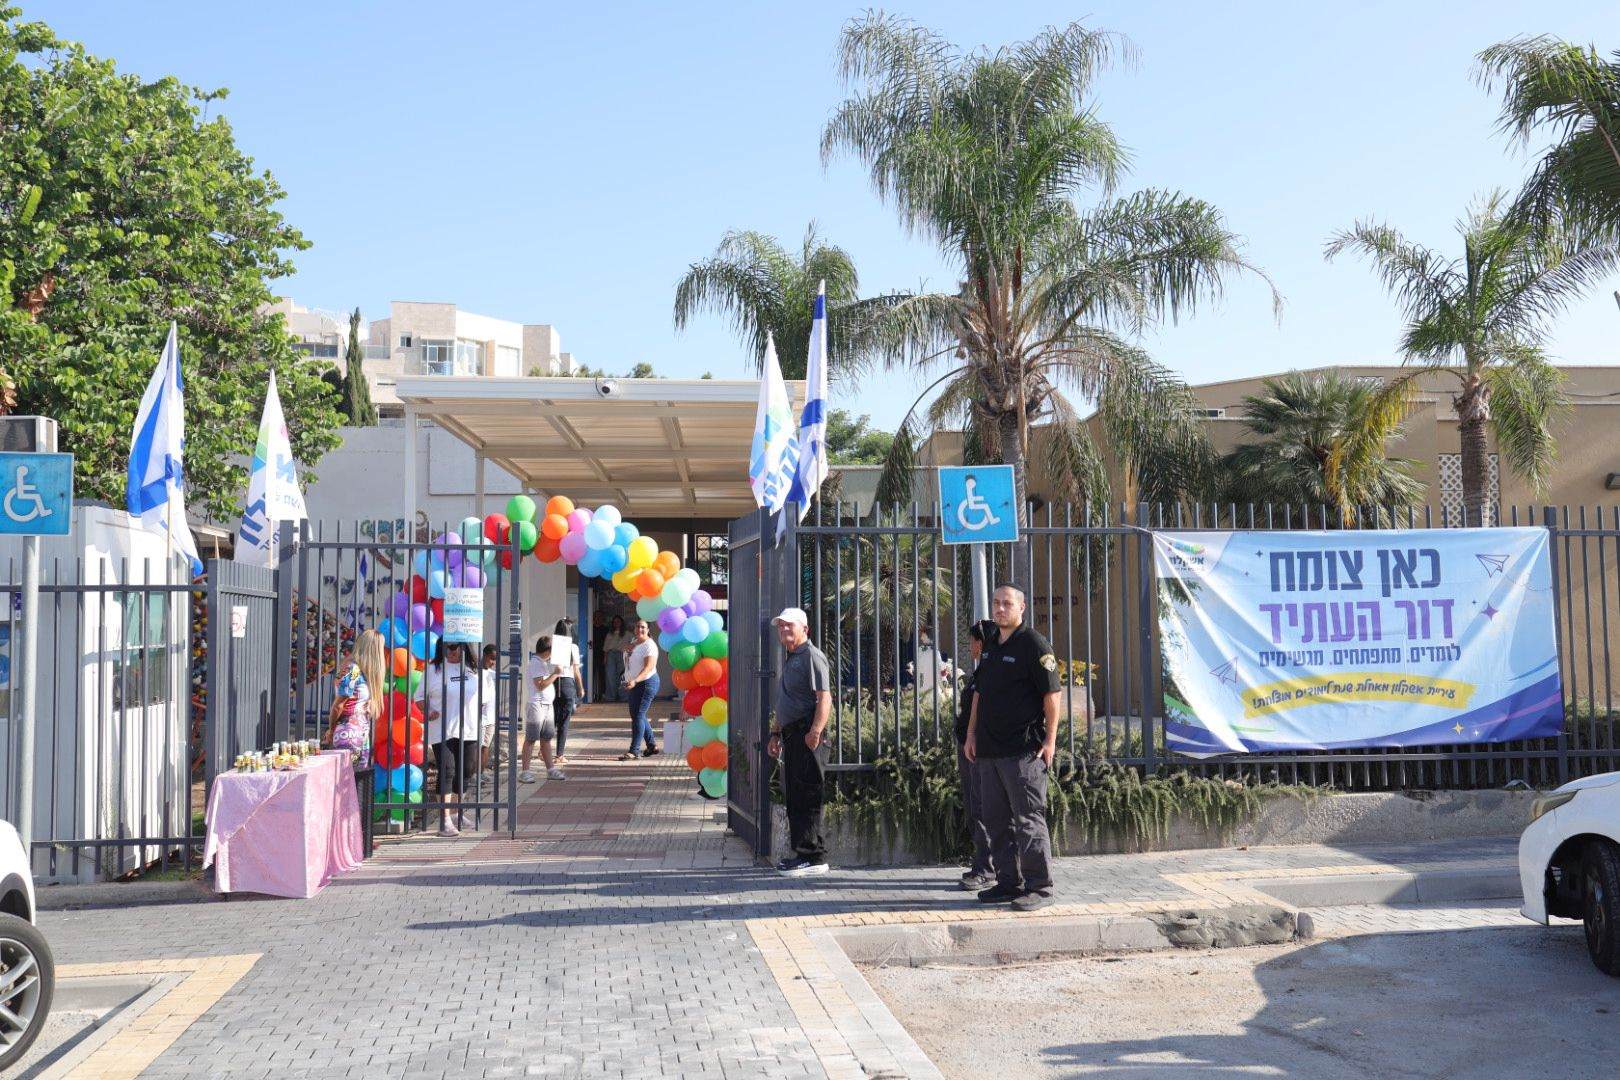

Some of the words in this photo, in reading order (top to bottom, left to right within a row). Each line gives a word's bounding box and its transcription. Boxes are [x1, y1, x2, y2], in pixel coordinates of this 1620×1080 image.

[1269, 550, 1363, 592] צומח
[1376, 548, 1441, 598] כאן
[1259, 601, 1382, 644] העתיד
[1394, 599, 1455, 640] דור
[1329, 647, 1401, 666] מתפתחים.
[1406, 643, 1462, 663] לומדים.
[1295, 681, 1334, 699] לימודים
[1334, 684, 1353, 694] שנת
[1355, 678, 1389, 692] מאחלת
[1391, 680, 1424, 695] אשקלון
